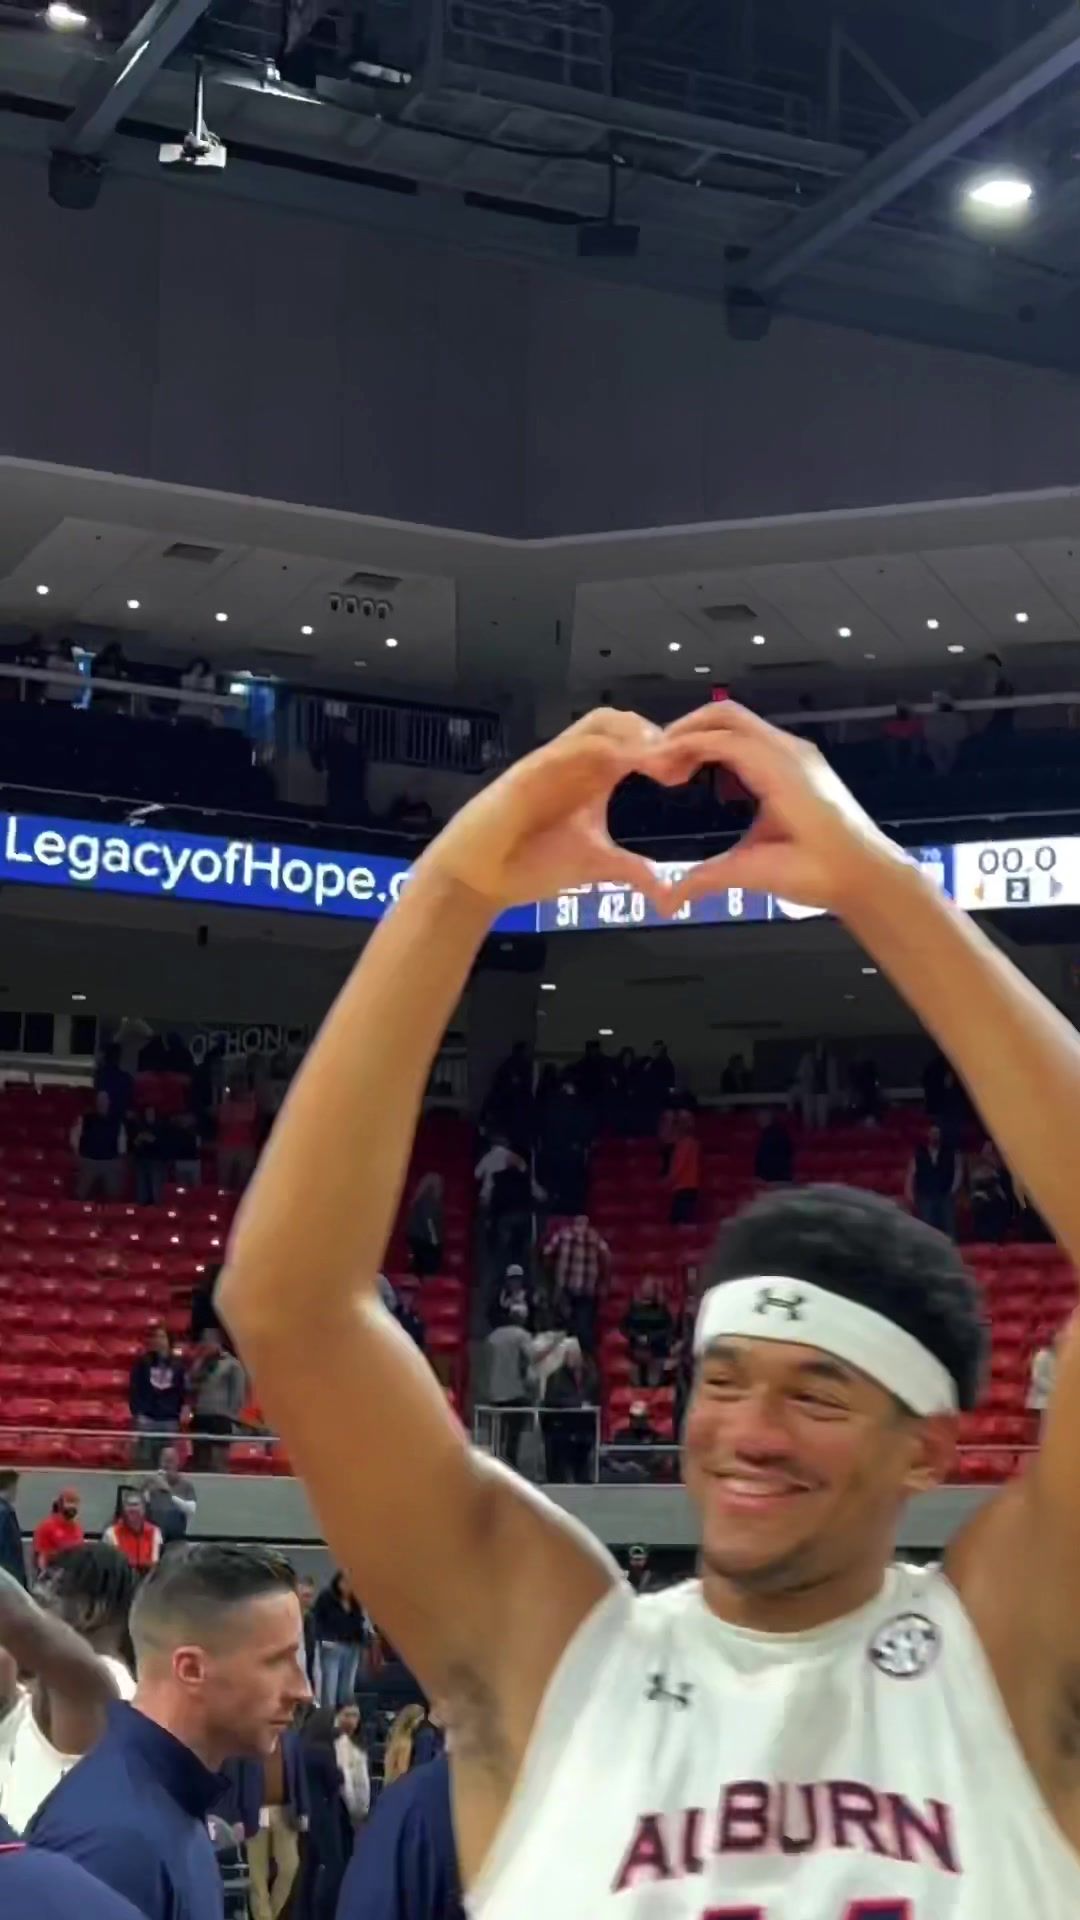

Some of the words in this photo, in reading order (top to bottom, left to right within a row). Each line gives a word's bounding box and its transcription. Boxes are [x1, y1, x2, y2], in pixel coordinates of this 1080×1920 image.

[978, 846, 1057, 875] 00.0
[1010, 881, 1025, 900] 2
[598, 892, 645, 924] 42.0
